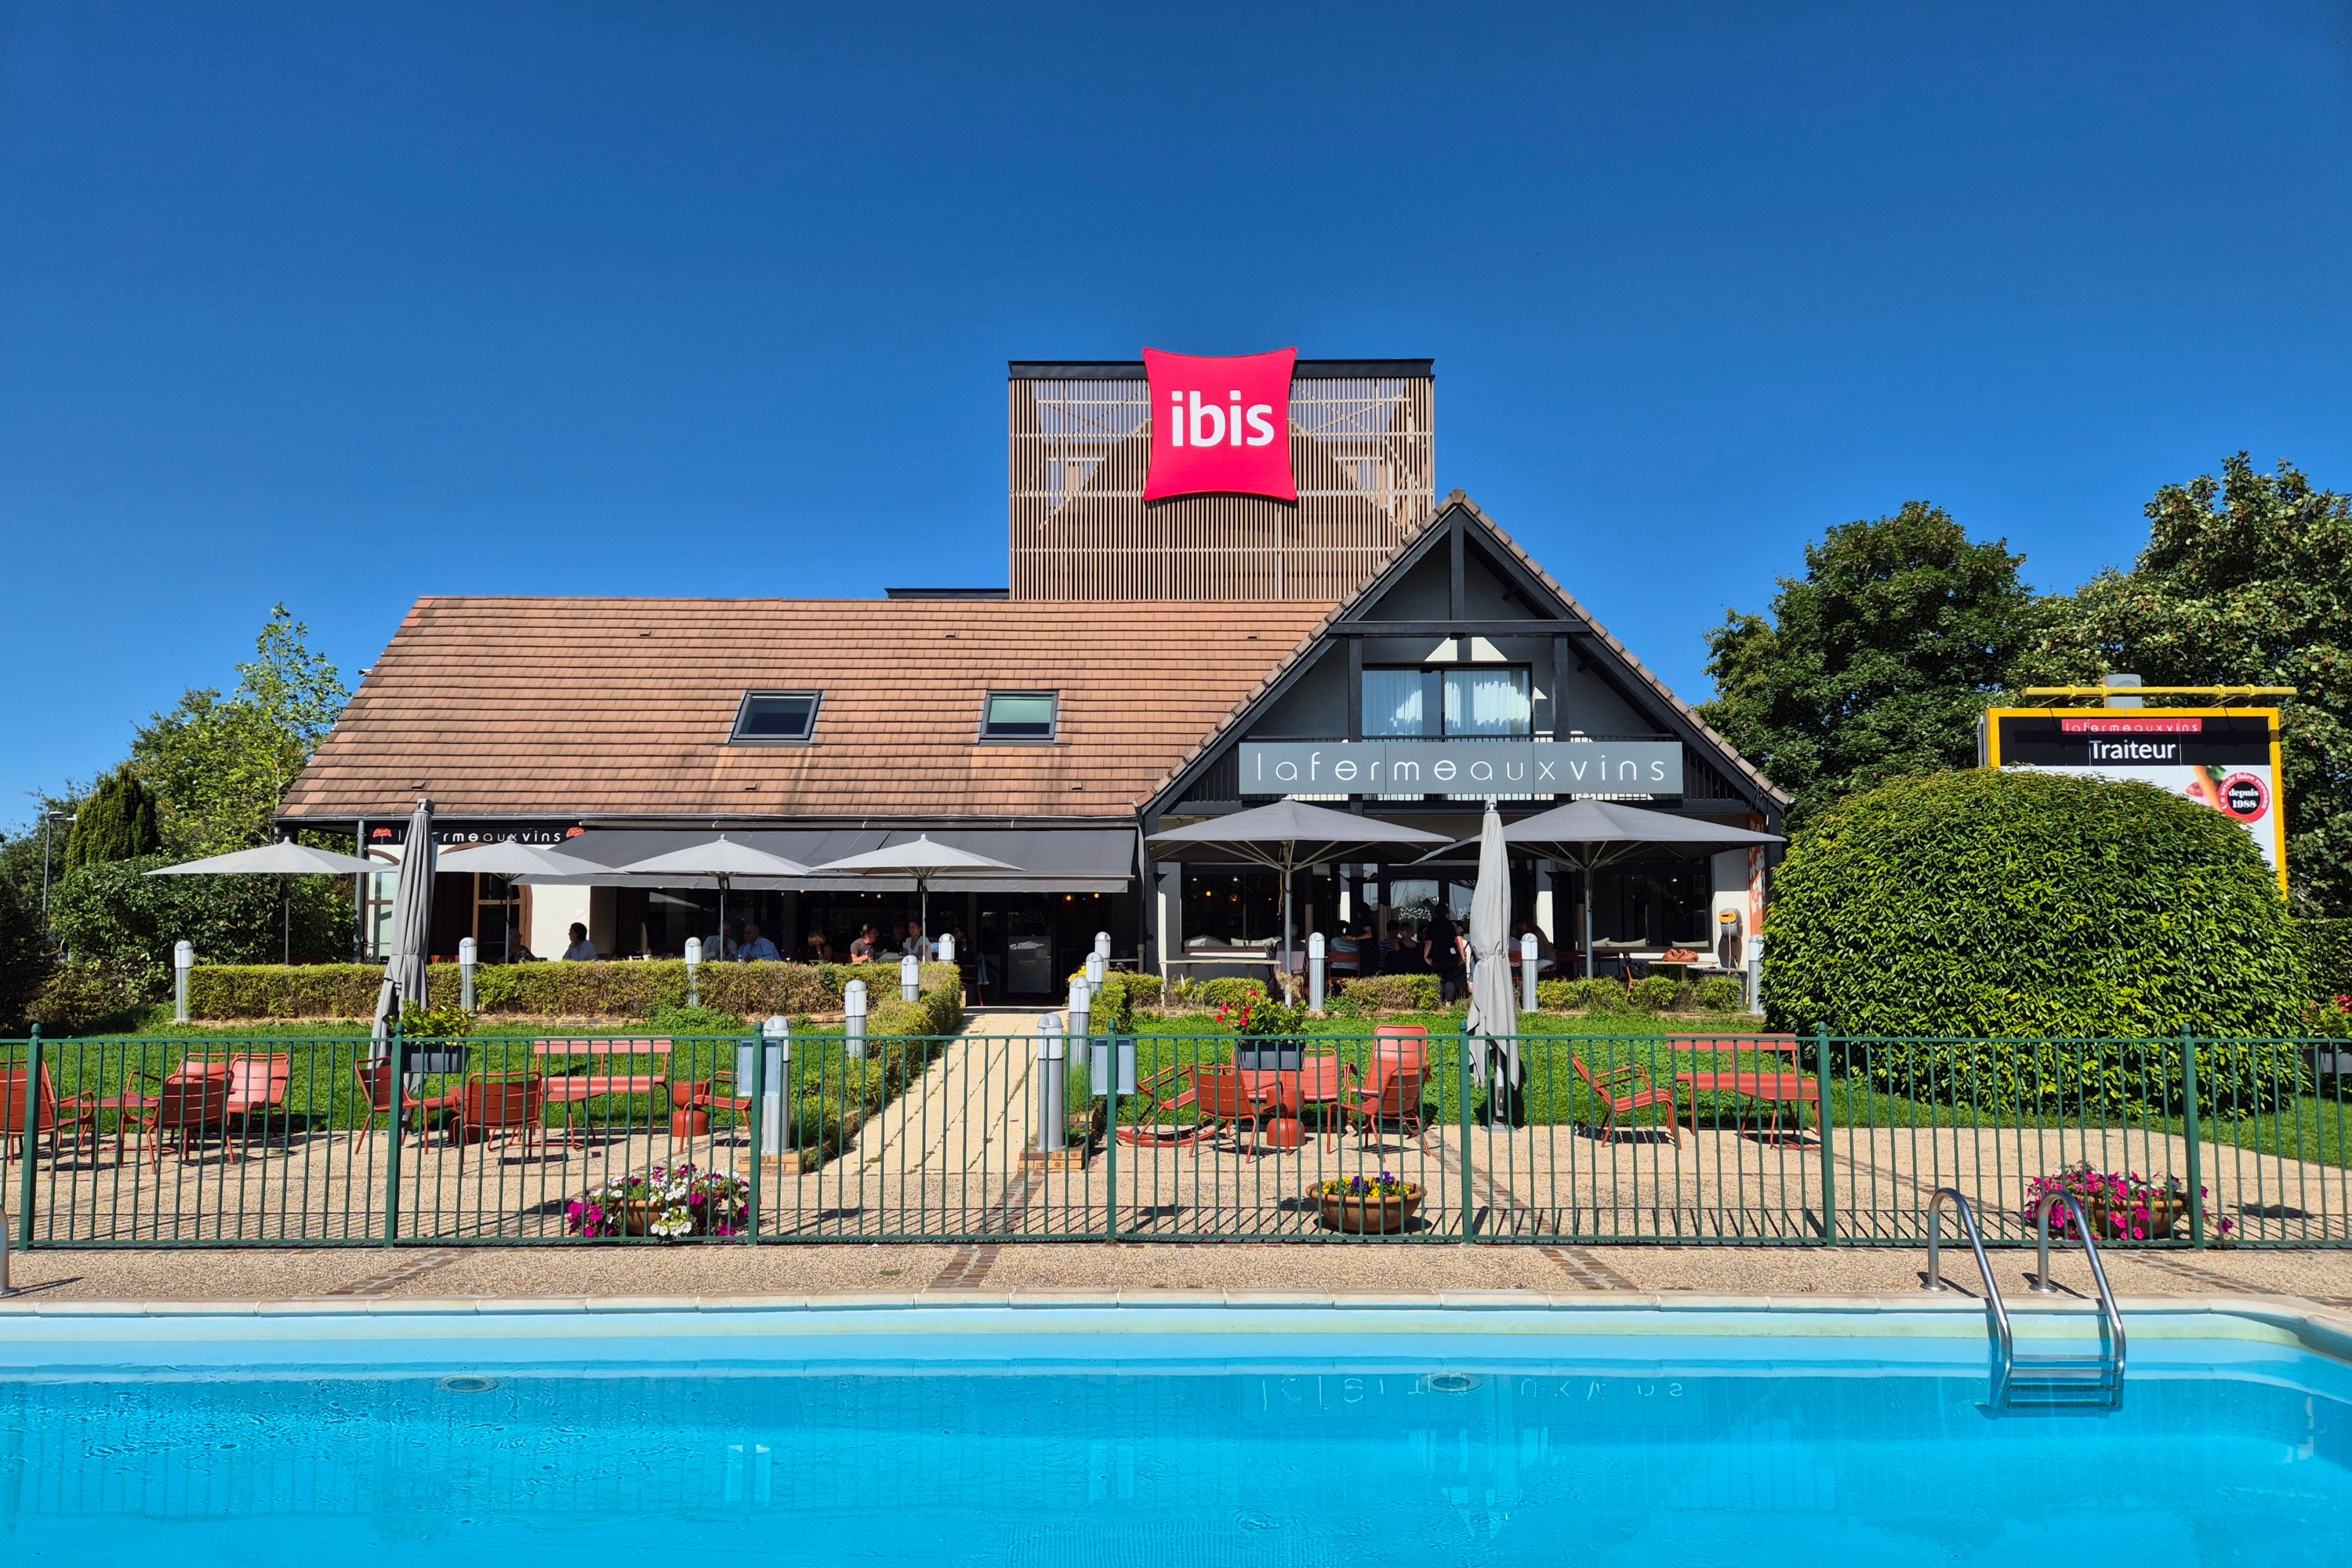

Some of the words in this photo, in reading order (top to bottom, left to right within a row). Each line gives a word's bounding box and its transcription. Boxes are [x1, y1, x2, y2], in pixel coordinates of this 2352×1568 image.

[1171, 390, 1275, 447] ibis
[2089, 739, 2176, 759] Traiteur
[1258, 752, 1665, 782] lafermeauxvins
[2228, 788, 2259, 799] depuis
[2232, 800, 2256, 808] 1988
